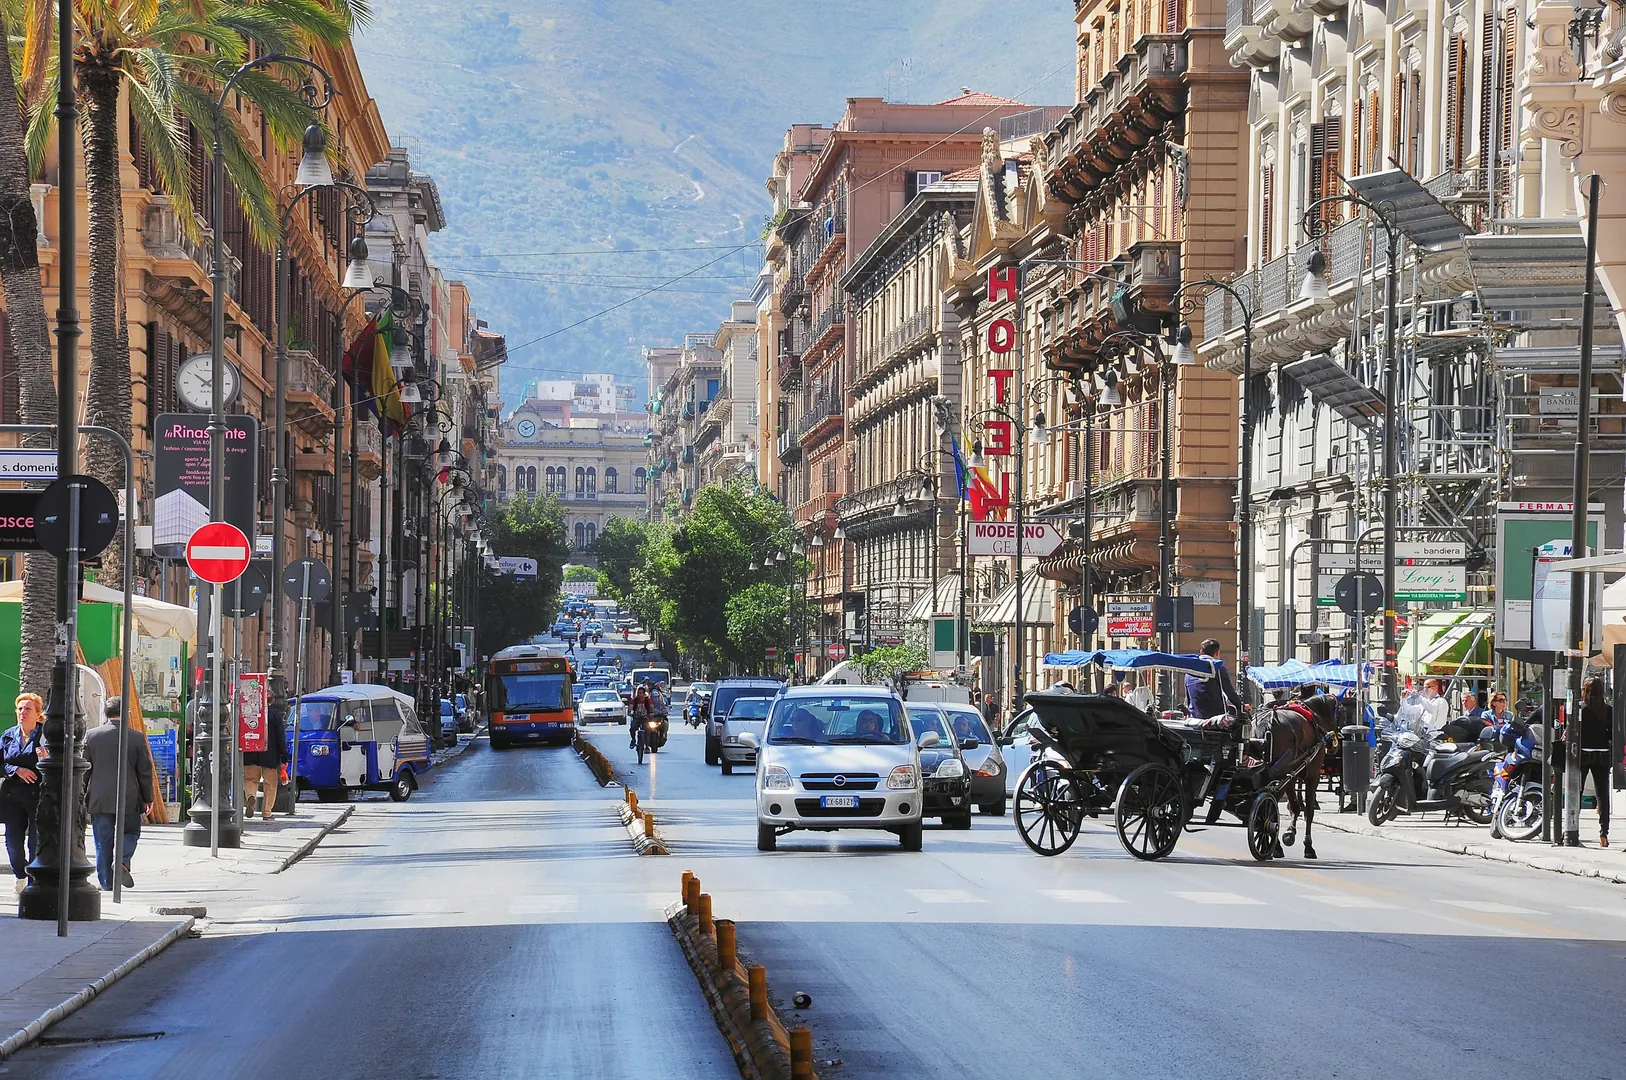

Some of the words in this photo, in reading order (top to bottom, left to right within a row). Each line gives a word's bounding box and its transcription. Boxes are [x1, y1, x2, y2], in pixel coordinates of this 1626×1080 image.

[981, 267, 1016, 507] HOTEL
[164, 424, 246, 440] laRinasnte
[1423, 547, 1461, 555] bandiera
[1398, 568, 1457, 587] Lory's
